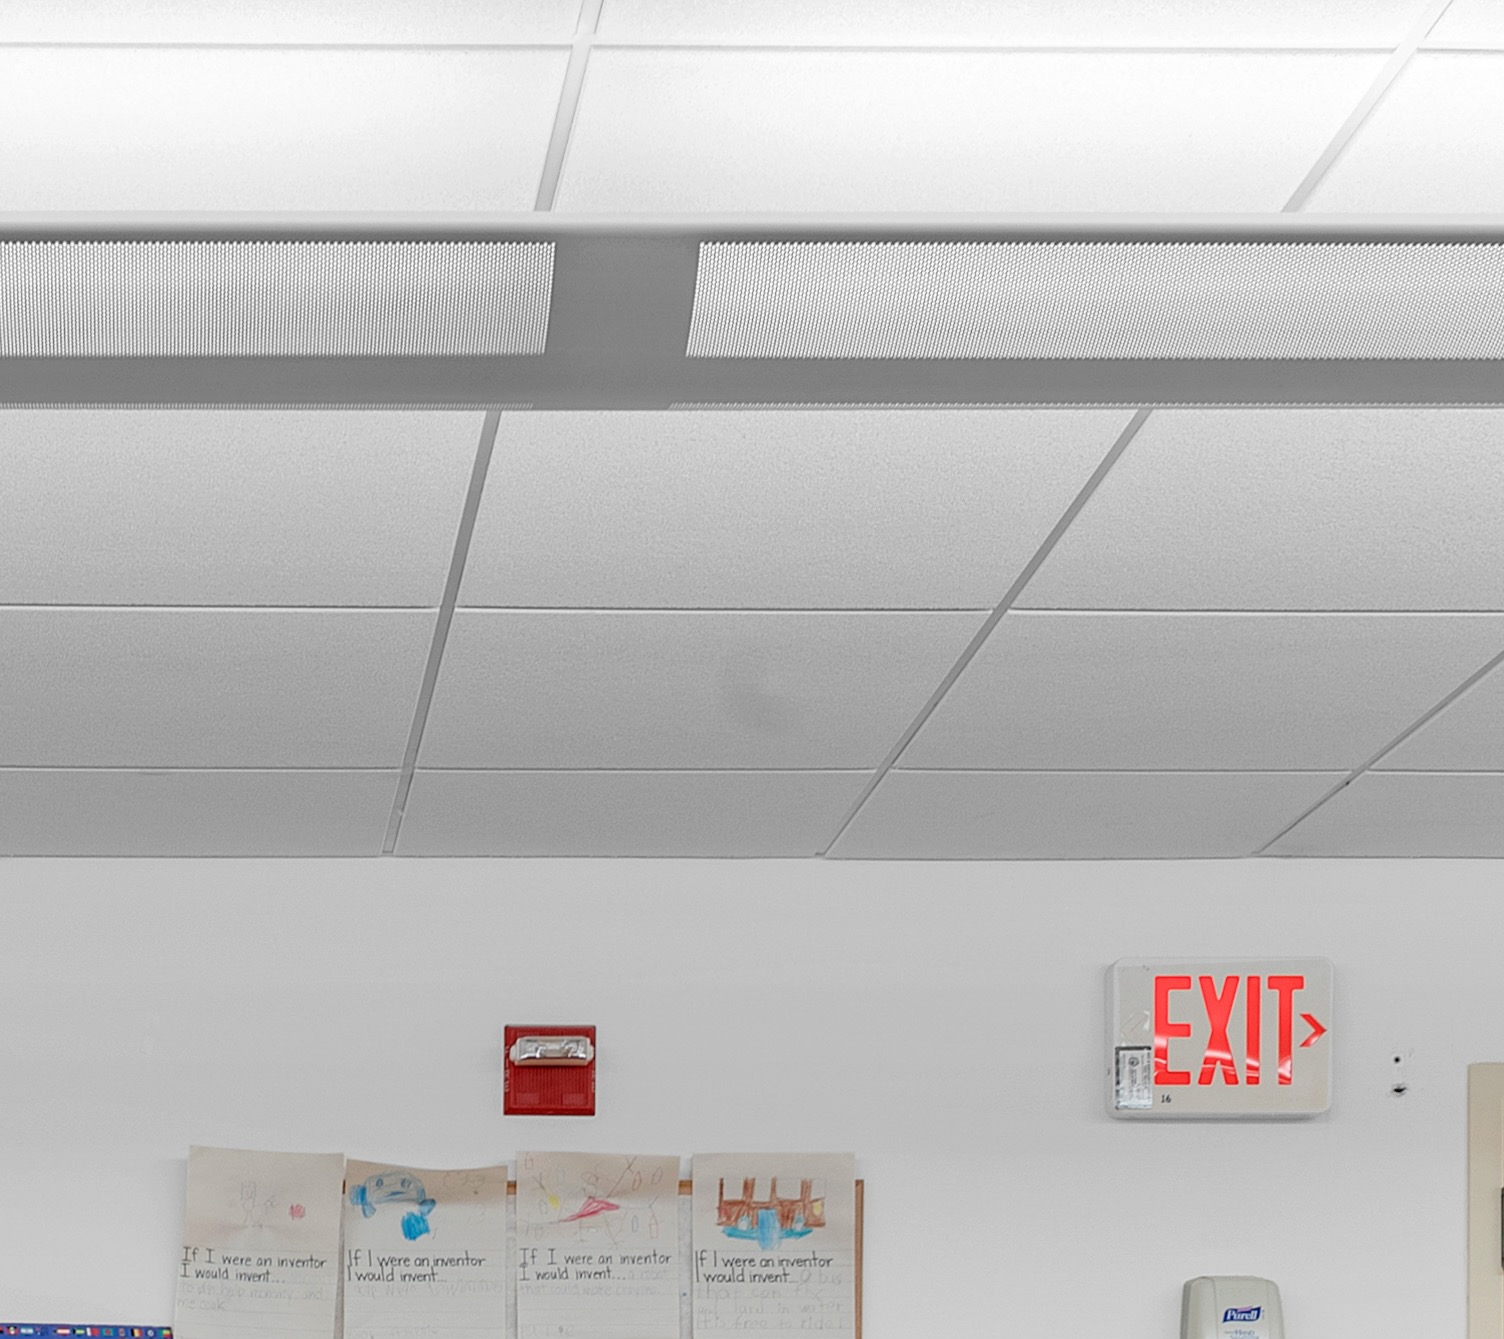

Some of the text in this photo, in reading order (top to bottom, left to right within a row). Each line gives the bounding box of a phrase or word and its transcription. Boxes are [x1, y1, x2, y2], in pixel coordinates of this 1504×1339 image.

[1154, 976, 1304, 1085] EXIT
[1161, 1095, 1171, 1103] 16
[182, 1246, 326, 1268] If I were an inventor
[181, 1263, 190, 1278] I
[196, 1268, 229, 1280] would
